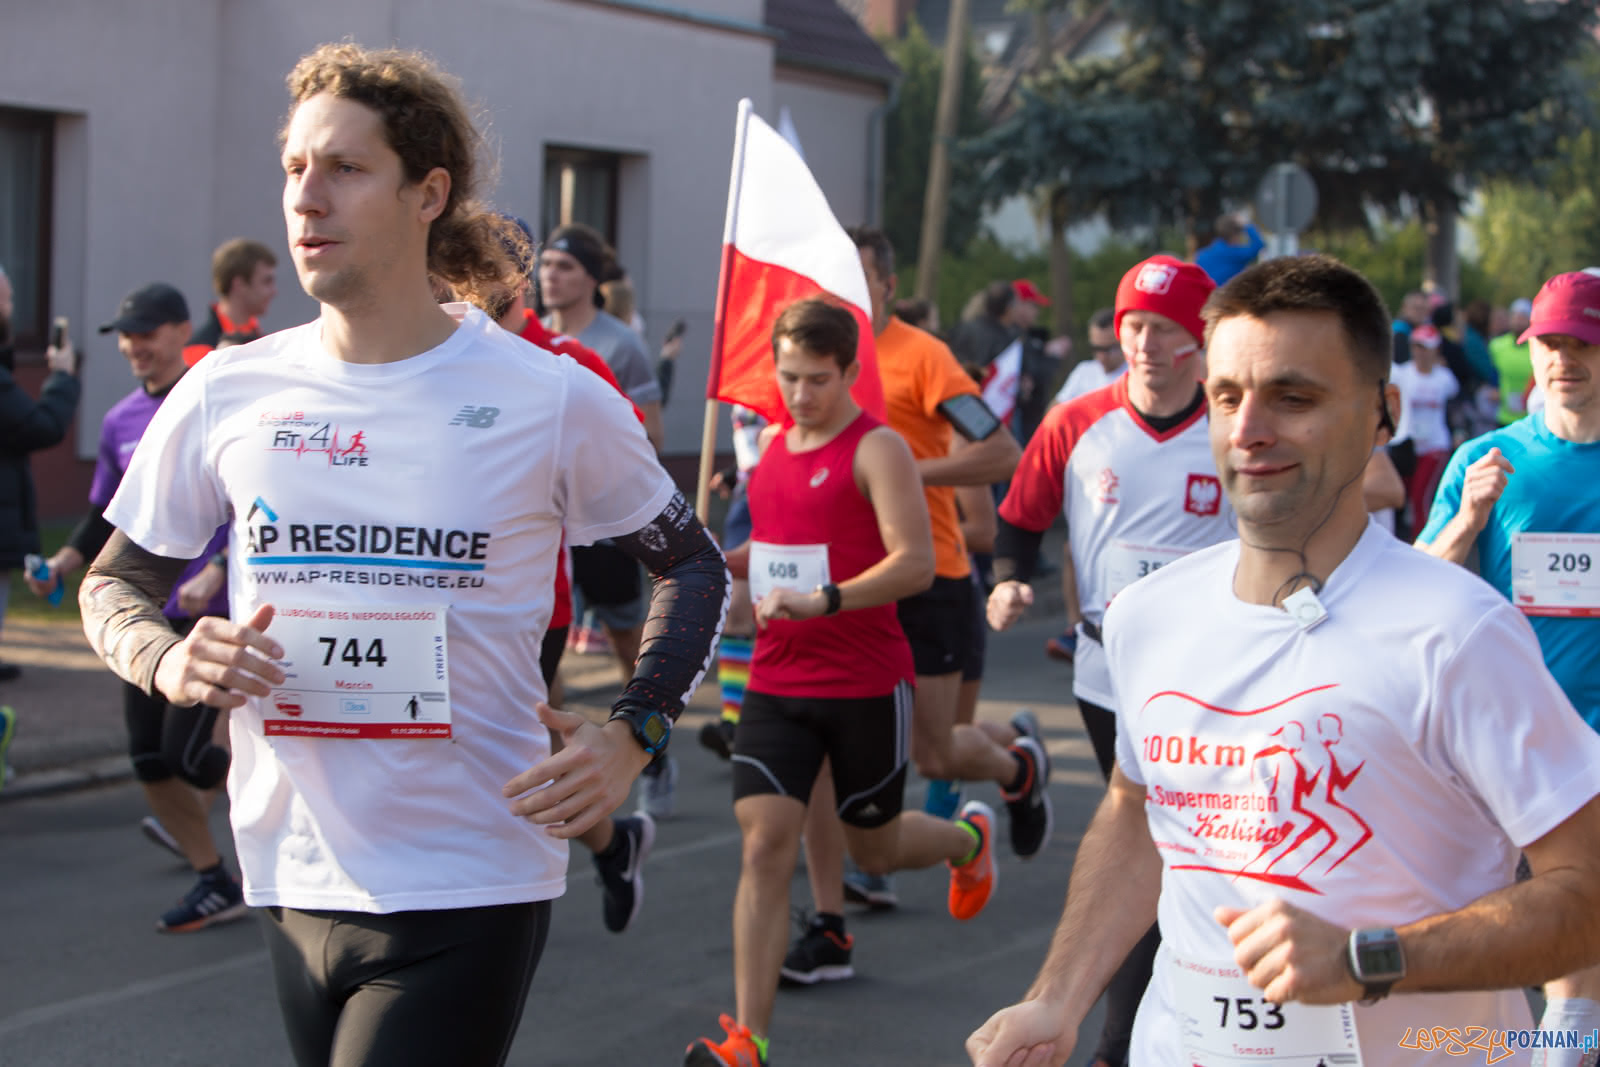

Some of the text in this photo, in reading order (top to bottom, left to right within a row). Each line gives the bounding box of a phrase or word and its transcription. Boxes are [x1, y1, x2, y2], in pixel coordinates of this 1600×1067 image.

[308, 421, 331, 448] 4
[332, 455, 369, 467] LIFE
[289, 524, 491, 561] RESIDENCE
[768, 561, 799, 580] 608
[1548, 553, 1591, 573] 209
[328, 611, 349, 621] BIEG
[319, 636, 387, 668] 744
[335, 679, 374, 690] Marcin
[1143, 735, 1246, 767] 100km
[1154, 785, 1278, 813] Supermaraton
[1213, 996, 1286, 1031] 753
[1232, 1043, 1275, 1056] Tomasz
